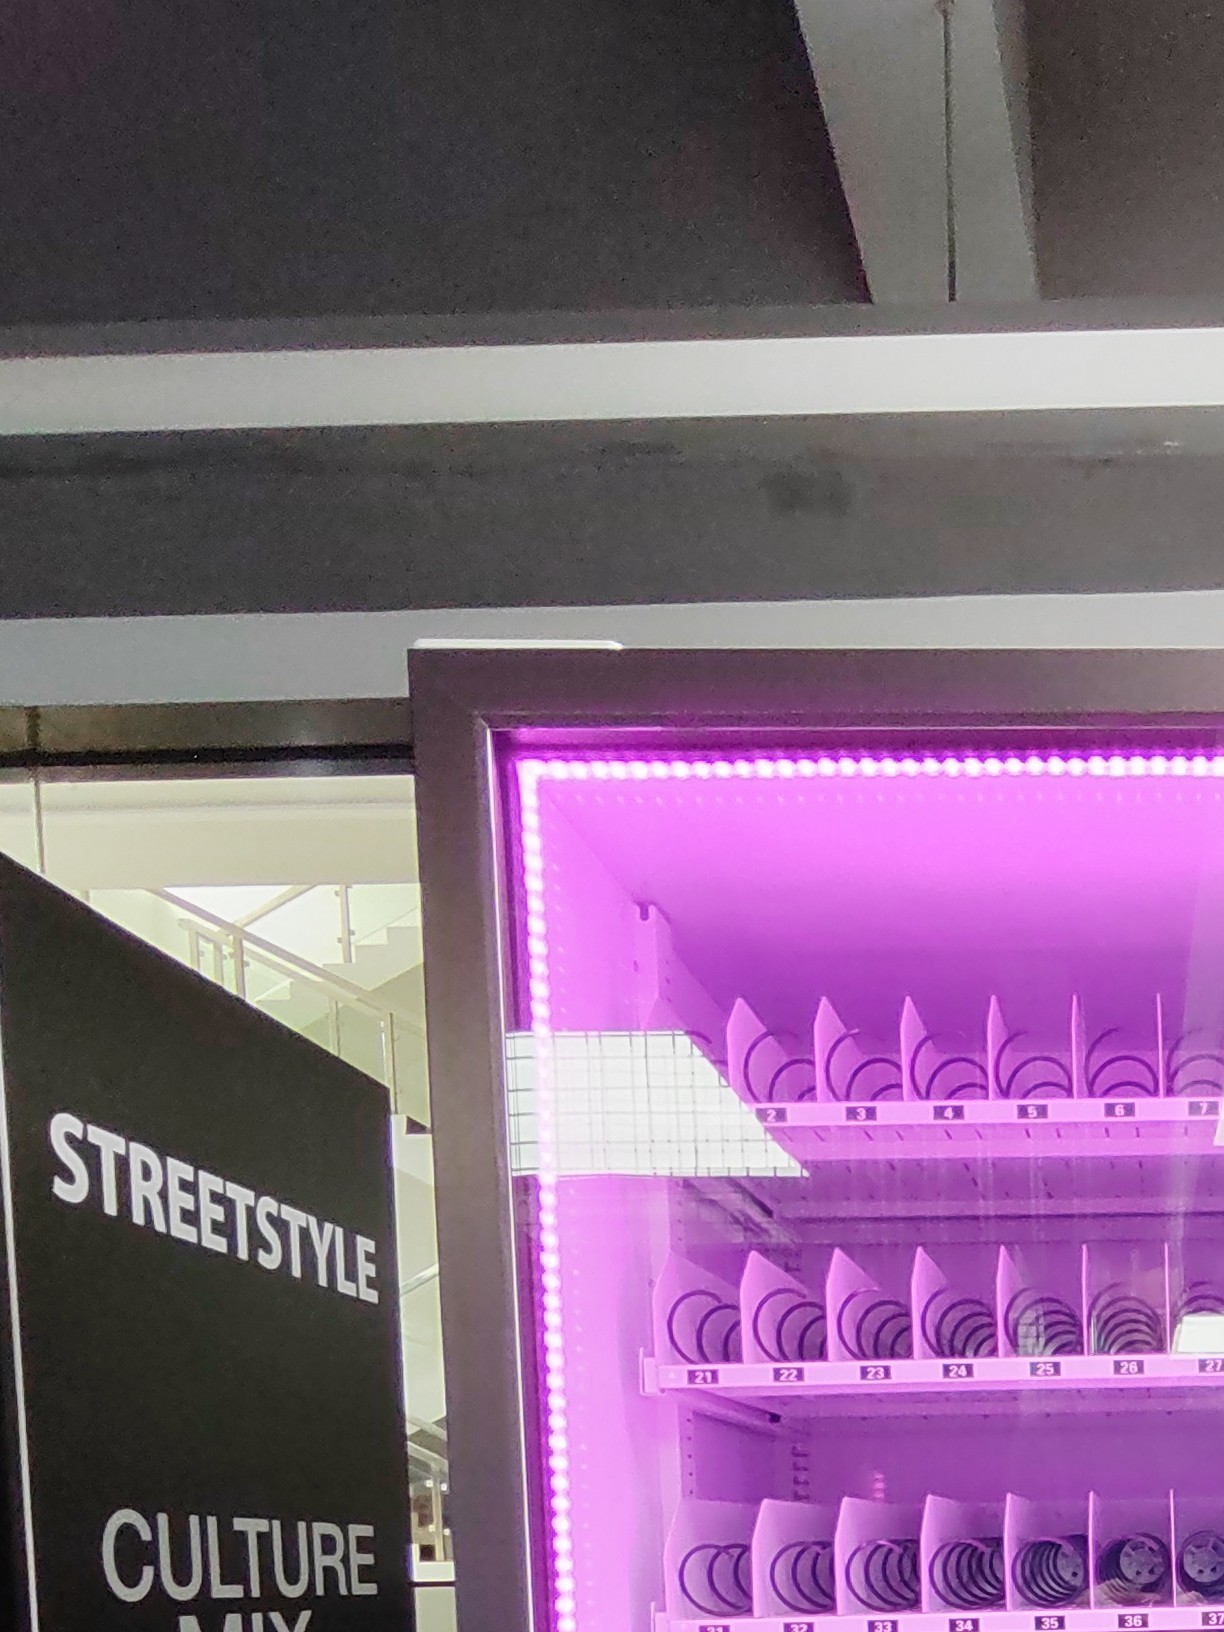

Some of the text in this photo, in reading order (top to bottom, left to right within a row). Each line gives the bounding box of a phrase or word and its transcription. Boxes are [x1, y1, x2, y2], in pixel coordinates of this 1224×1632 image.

[49, 1112, 379, 1303] STREETSTYLE
[695, 1371, 712, 1383] 21
[779, 1368, 798, 1381] 22
[866, 1367, 884, 1379] 23
[949, 1365, 967, 1378] 24
[1036, 1363, 1054, 1375] 25
[1120, 1361, 1138, 1374] 26
[1205, 1359, 1222, 1372] 27
[102, 1508, 378, 1602] CULTURE
[874, 1621, 892, 1632] 33
[955, 1620, 973, 1632] 34
[1041, 1617, 1059, 1629] 35
[1124, 1615, 1142, 1627] 36
[1208, 1612, 1224, 1624] 37
